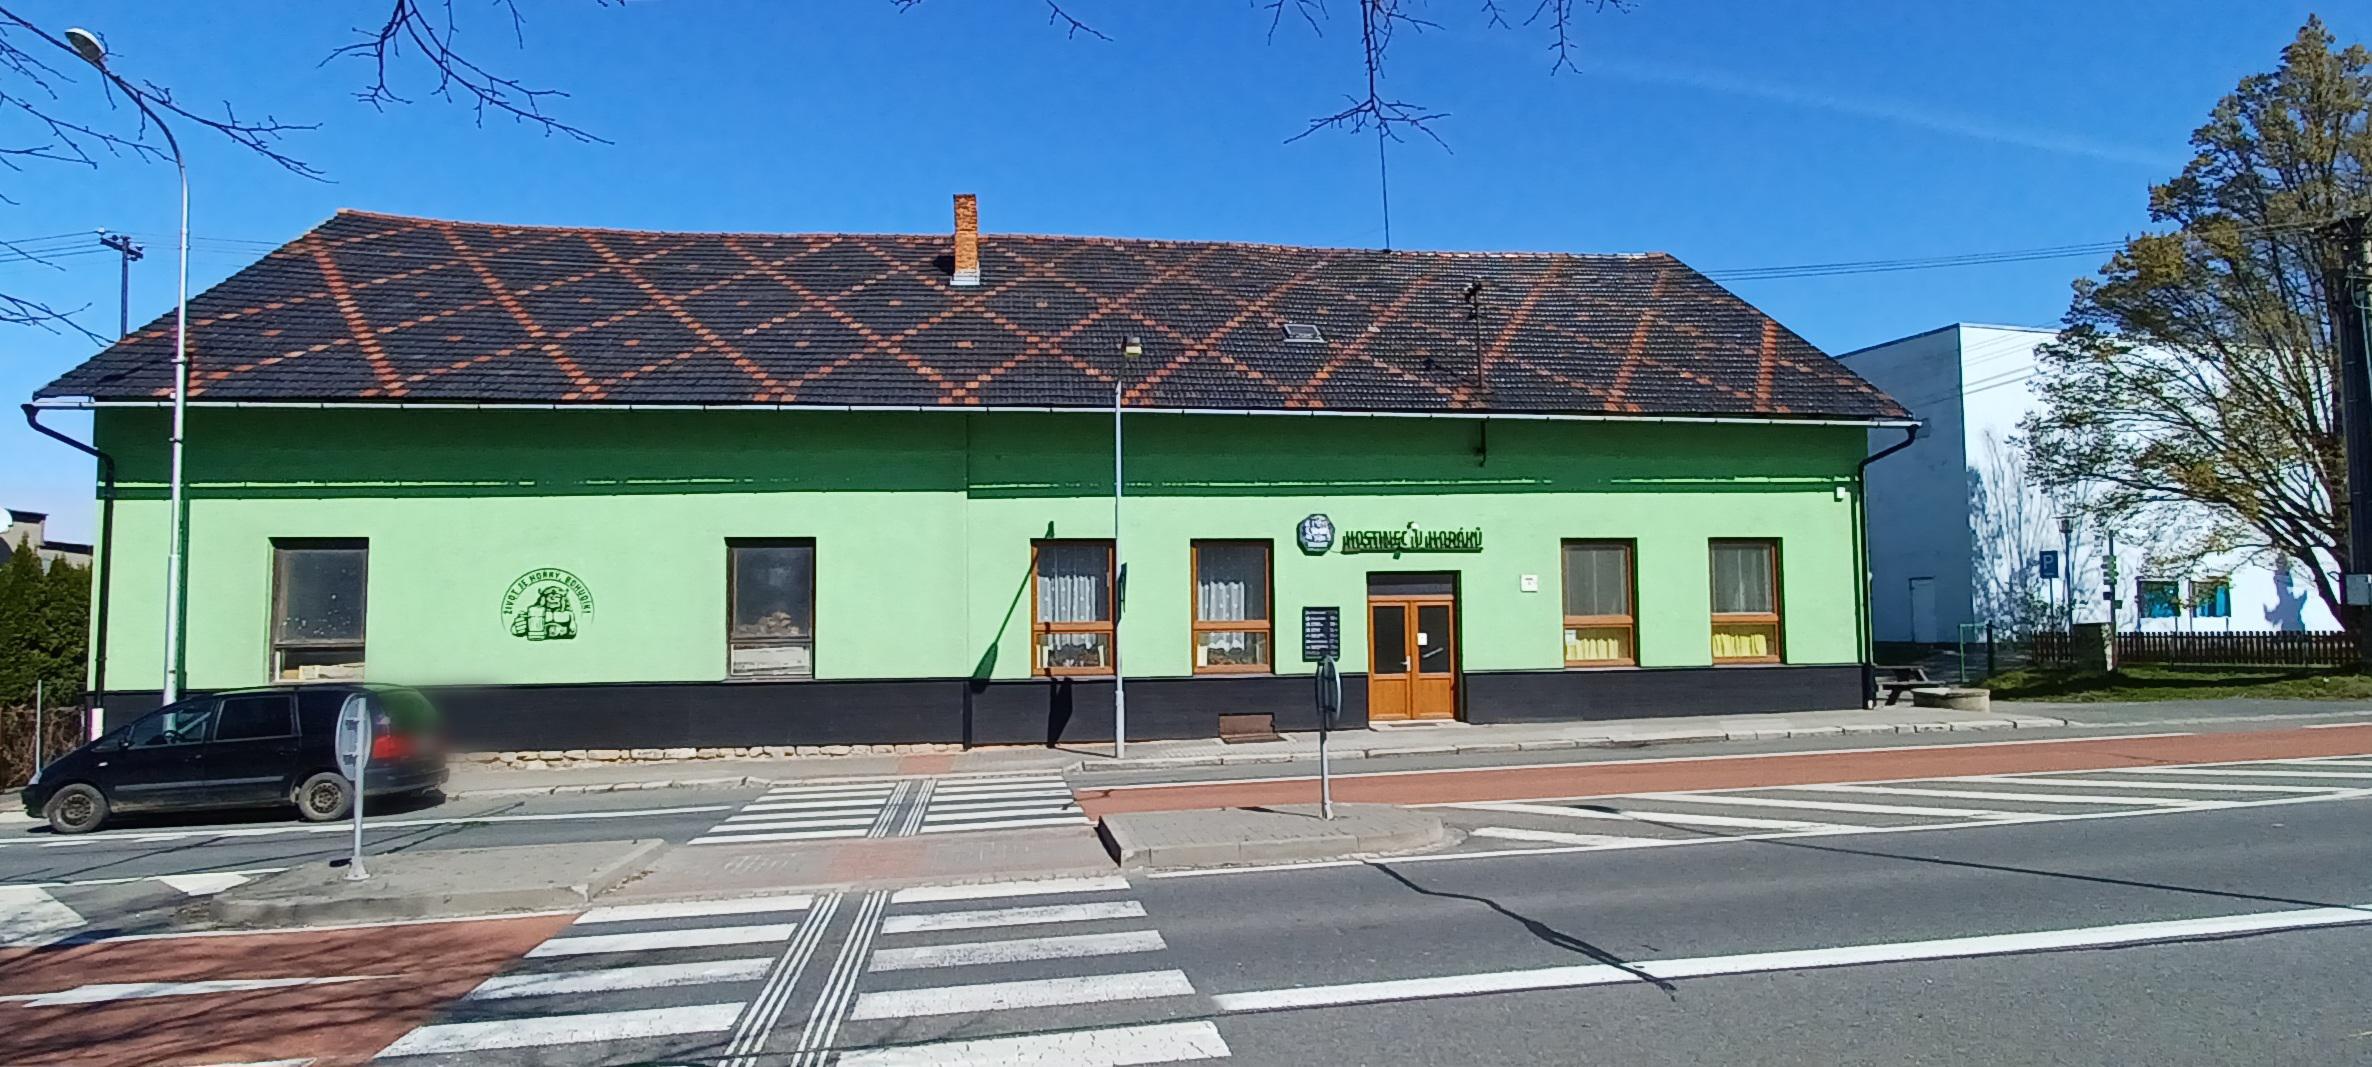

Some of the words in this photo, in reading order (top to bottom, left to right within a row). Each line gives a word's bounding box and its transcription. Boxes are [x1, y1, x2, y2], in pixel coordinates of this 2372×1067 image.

[1345, 530, 1407, 548] HOSTINEC
[1412, 530, 1423, 547] U
[1427, 526, 1483, 548] HORÁKŮ
[2043, 554, 2054, 570] P
[518, 579, 529, 590] JE
